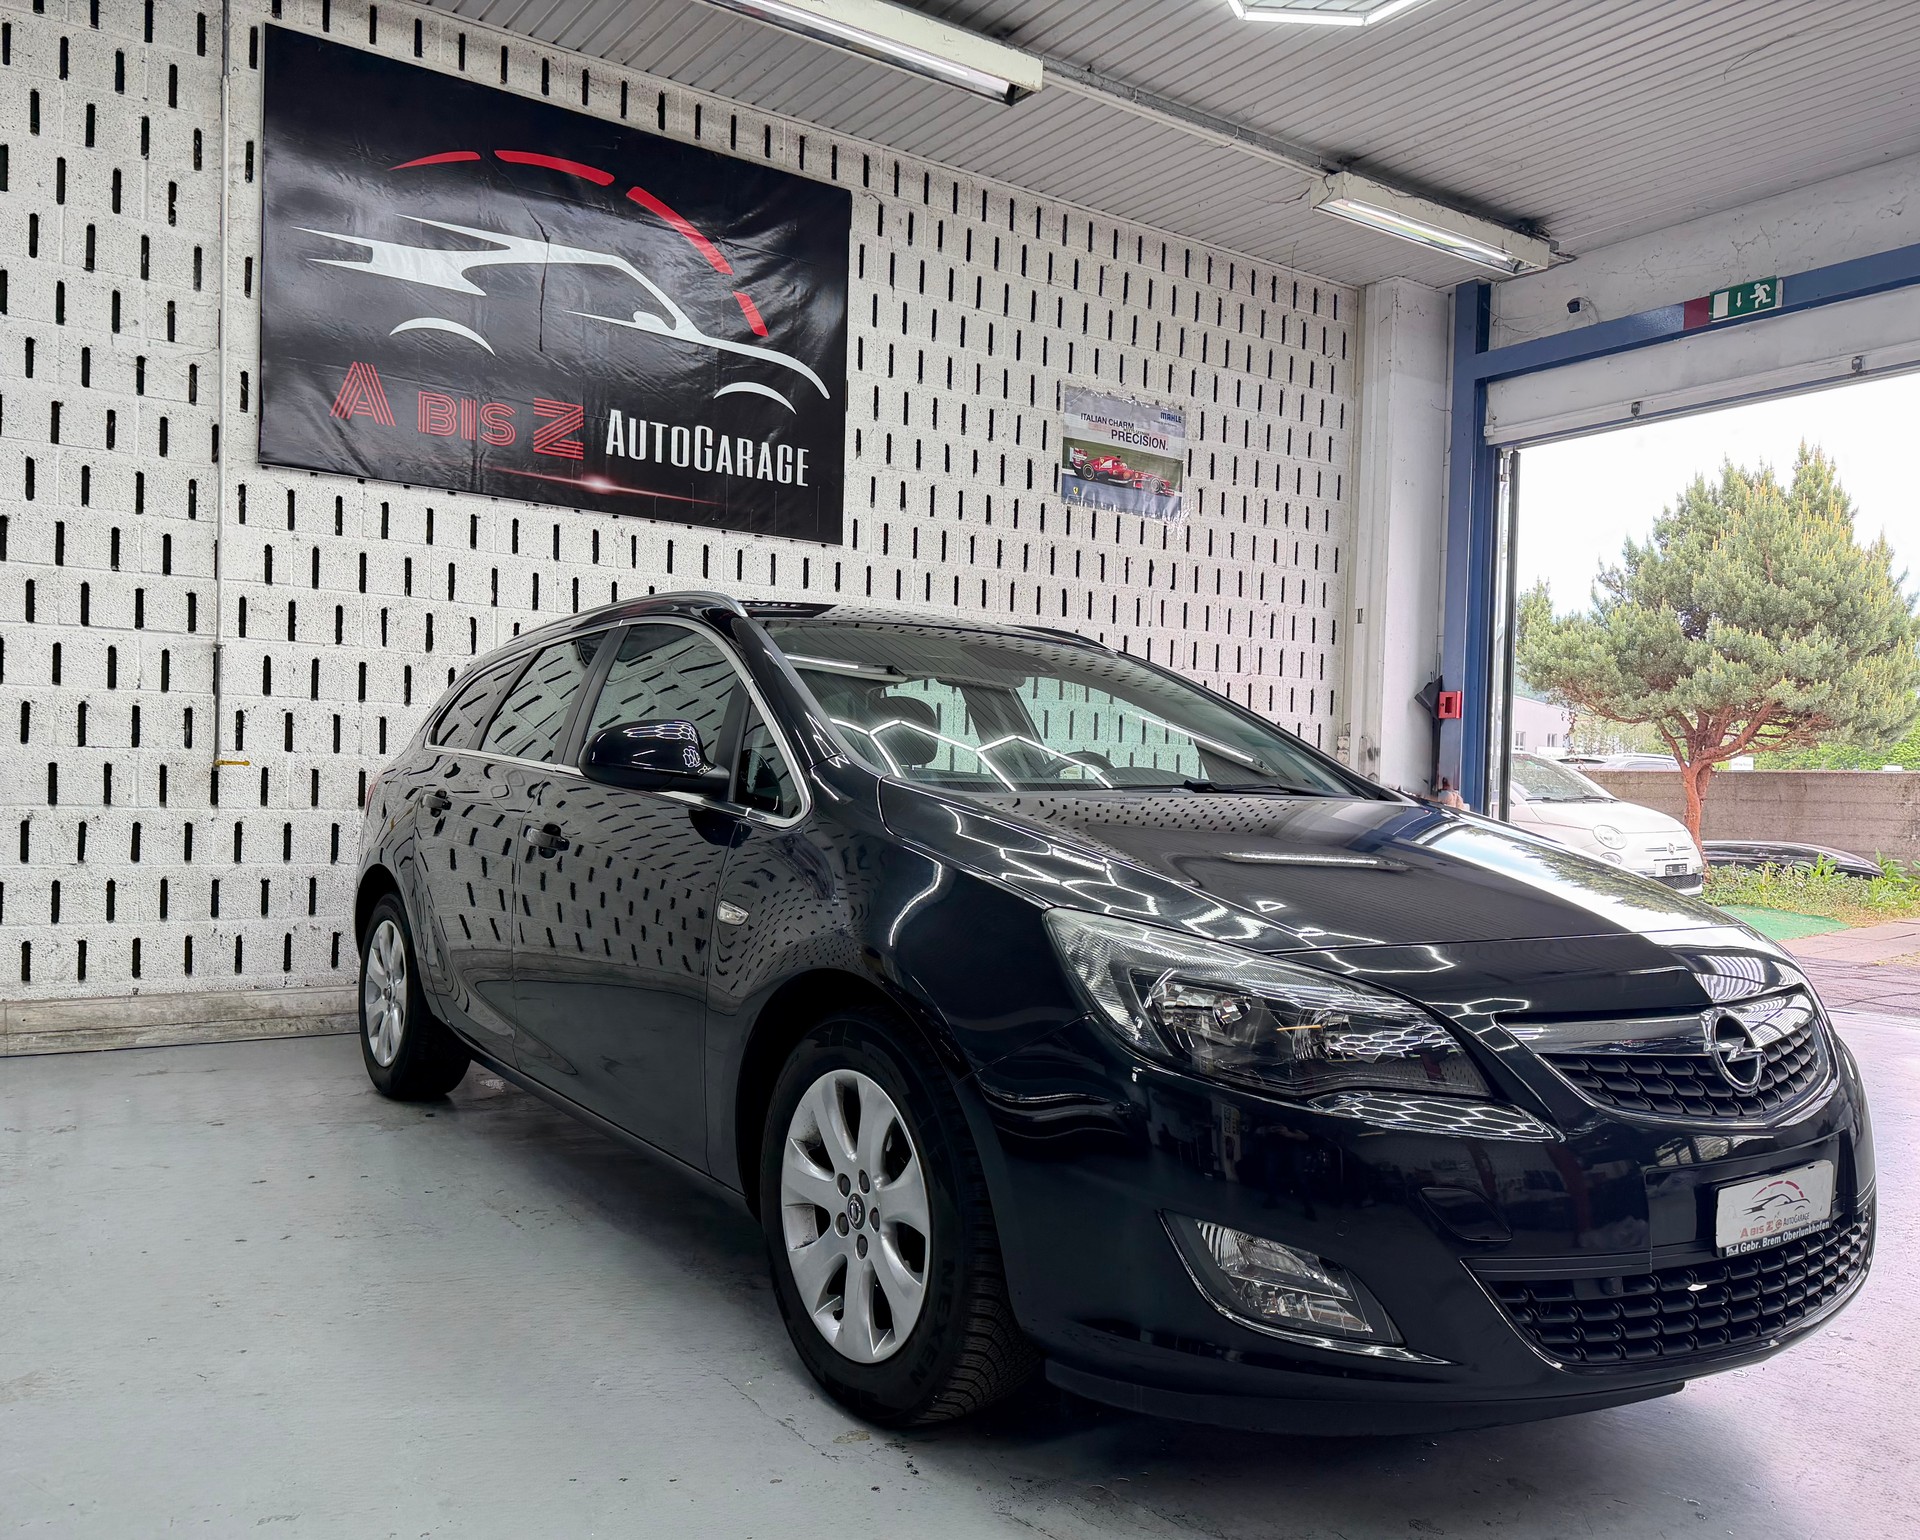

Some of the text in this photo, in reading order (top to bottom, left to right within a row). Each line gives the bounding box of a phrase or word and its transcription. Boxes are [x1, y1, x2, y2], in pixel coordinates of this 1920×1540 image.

[329, 361, 395, 426] A
[418, 391, 516, 446] BIS
[533, 397, 584, 460] Z
[1080, 412, 1134, 430] ITALIAN CHARM
[1160, 411, 1182, 423] MAHLE
[1111, 429, 1168, 451] PRECISION.
[1740, 1220, 1830, 1253] Gebr. Brem Oberlunkhofen
[909, 1258, 956, 1386] NEXEN
